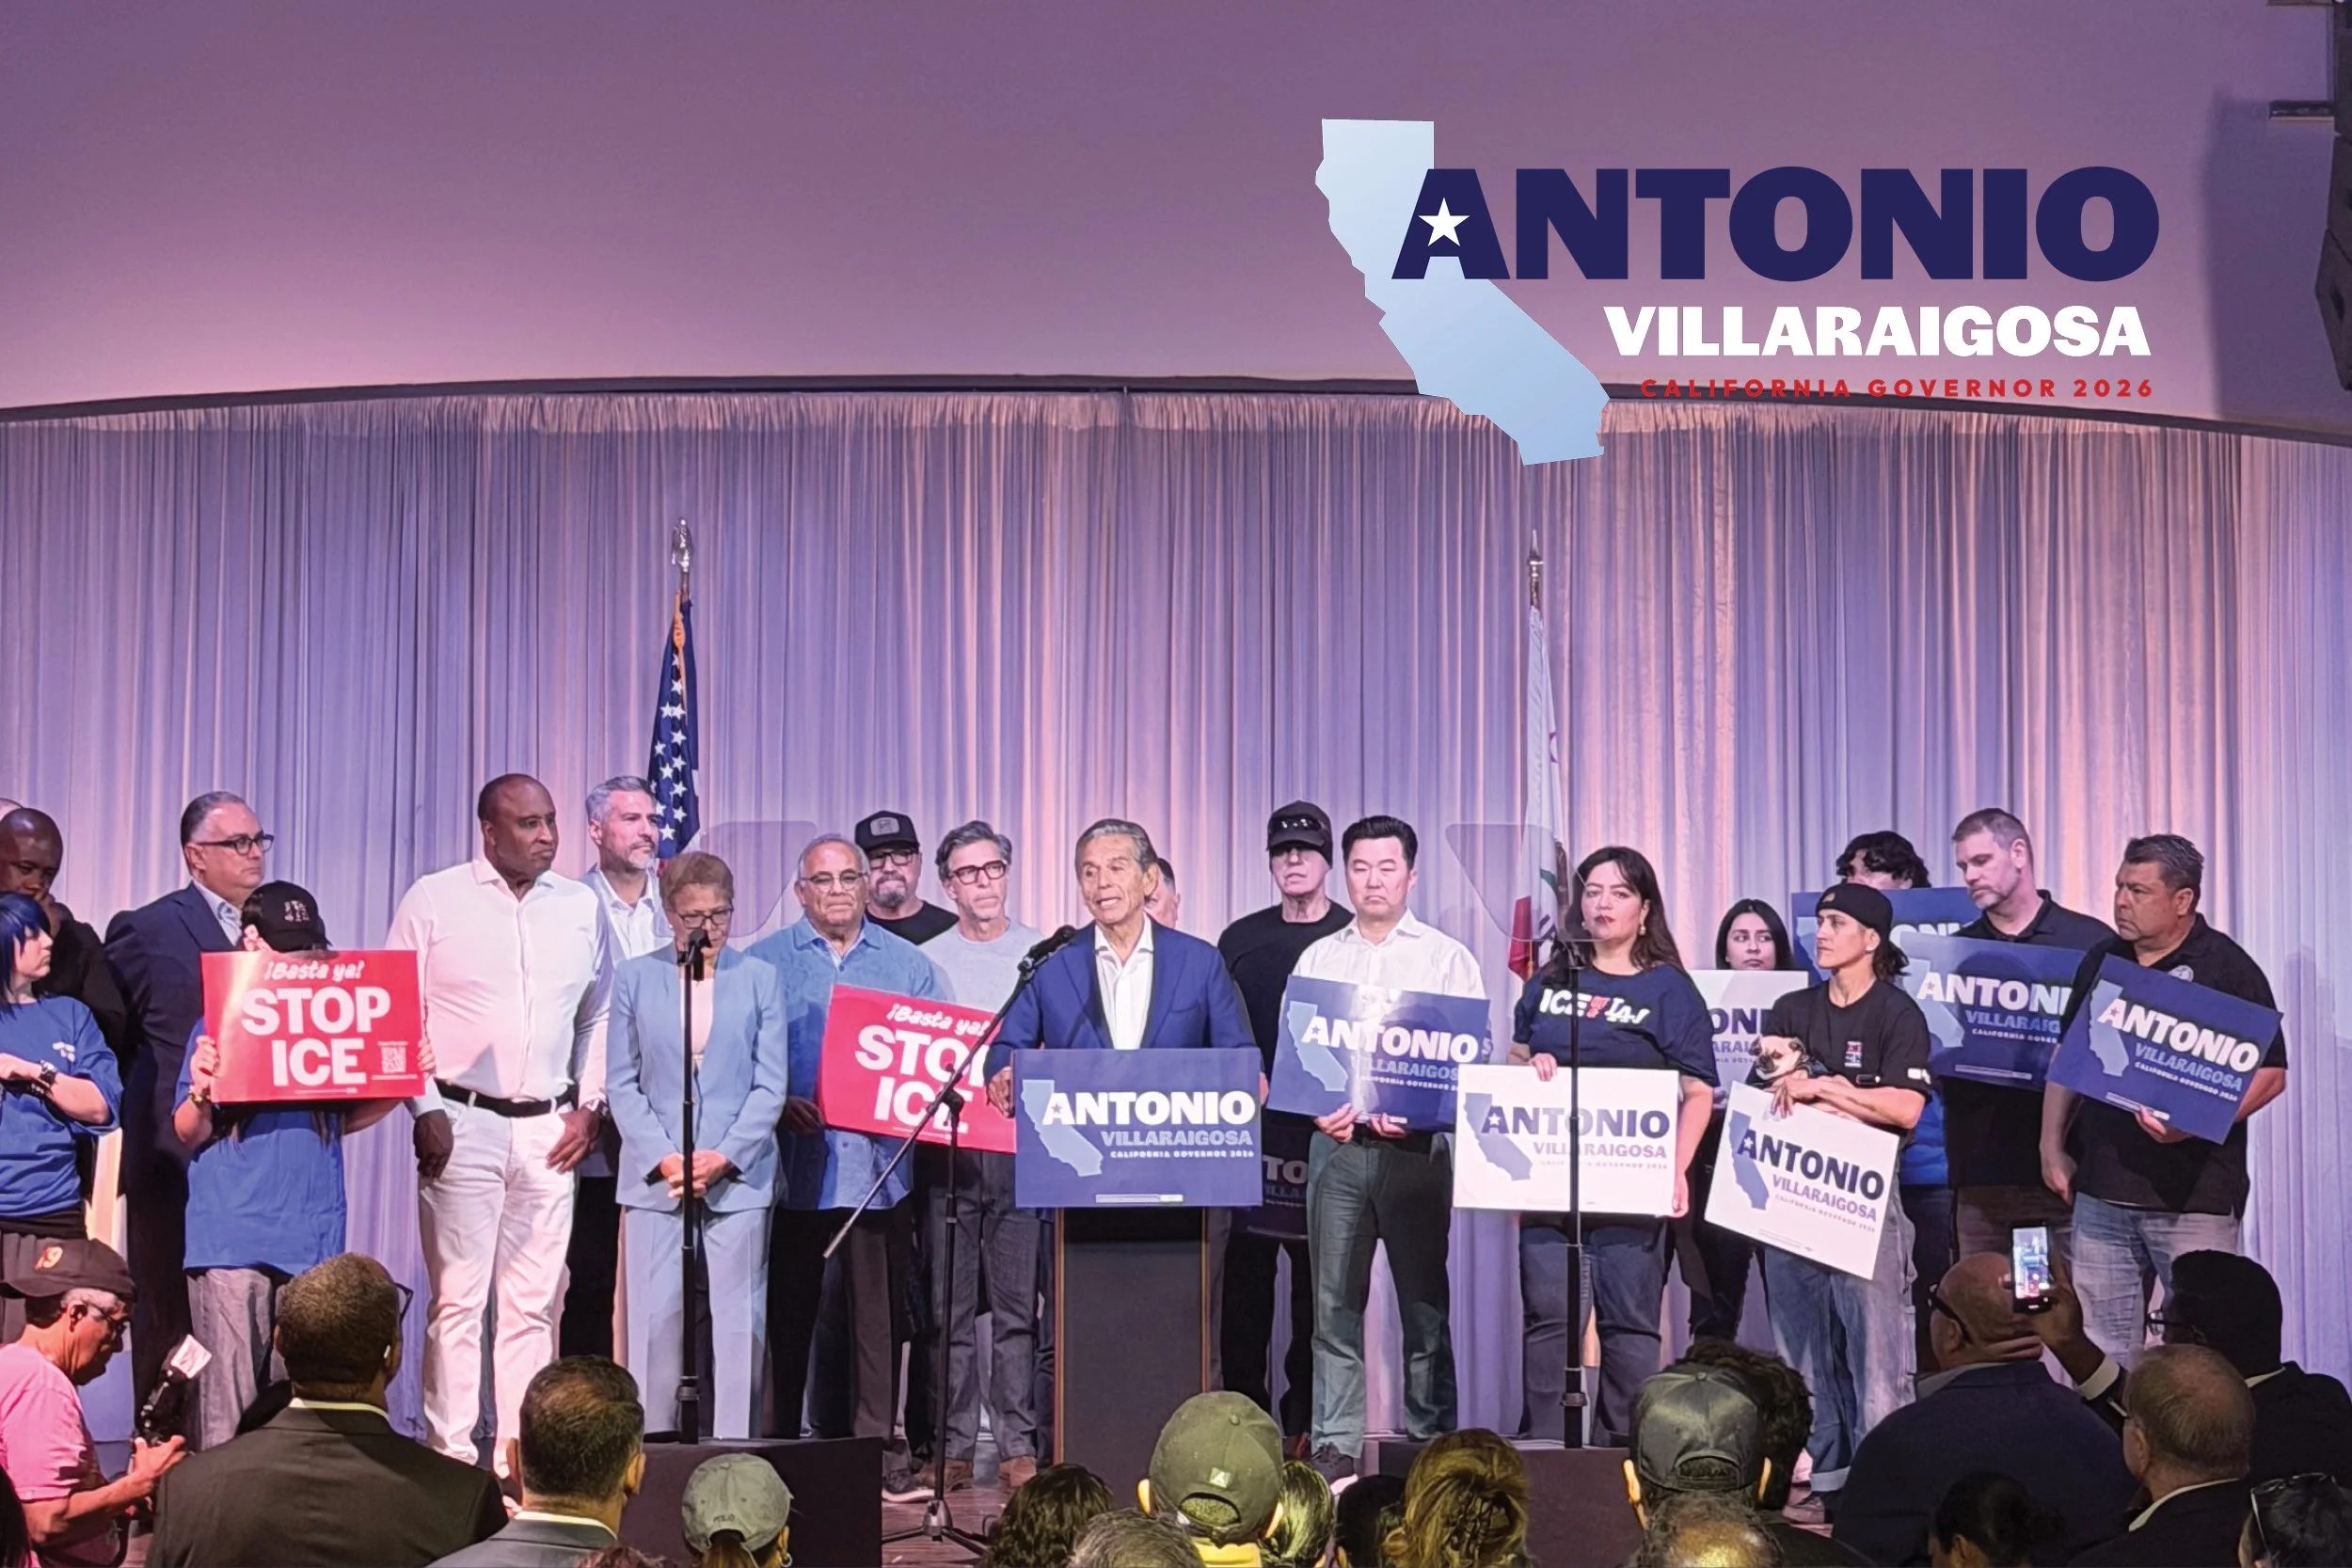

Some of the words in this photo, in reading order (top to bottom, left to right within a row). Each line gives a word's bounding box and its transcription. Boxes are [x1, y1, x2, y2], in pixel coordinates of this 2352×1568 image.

[332, 959, 365, 982] ya!
[241, 986, 391, 1036] STOP
[1915, 972, 2073, 1016] ANTONI
[1301, 1015, 1478, 1063] ANTONIO
[1964, 1009, 2060, 1034] VILLARAIG
[2098, 998, 2260, 1072] ANTONIO
[272, 1037, 367, 1086] ICE
[2135, 1042, 2243, 1091] VILLARAIGOSA
[1042, 1090, 1256, 1125] ANTONIO
[1481, 1105, 1670, 1139] ANTONIO
[1100, 1129, 1254, 1147] VILLARAIGOSA
[1533, 1141, 1668, 1159] VILLRAIGOSA
[1737, 1129, 1884, 1200] ANTONIO
[1772, 1173, 1877, 1223] VILLARAIGOSA
